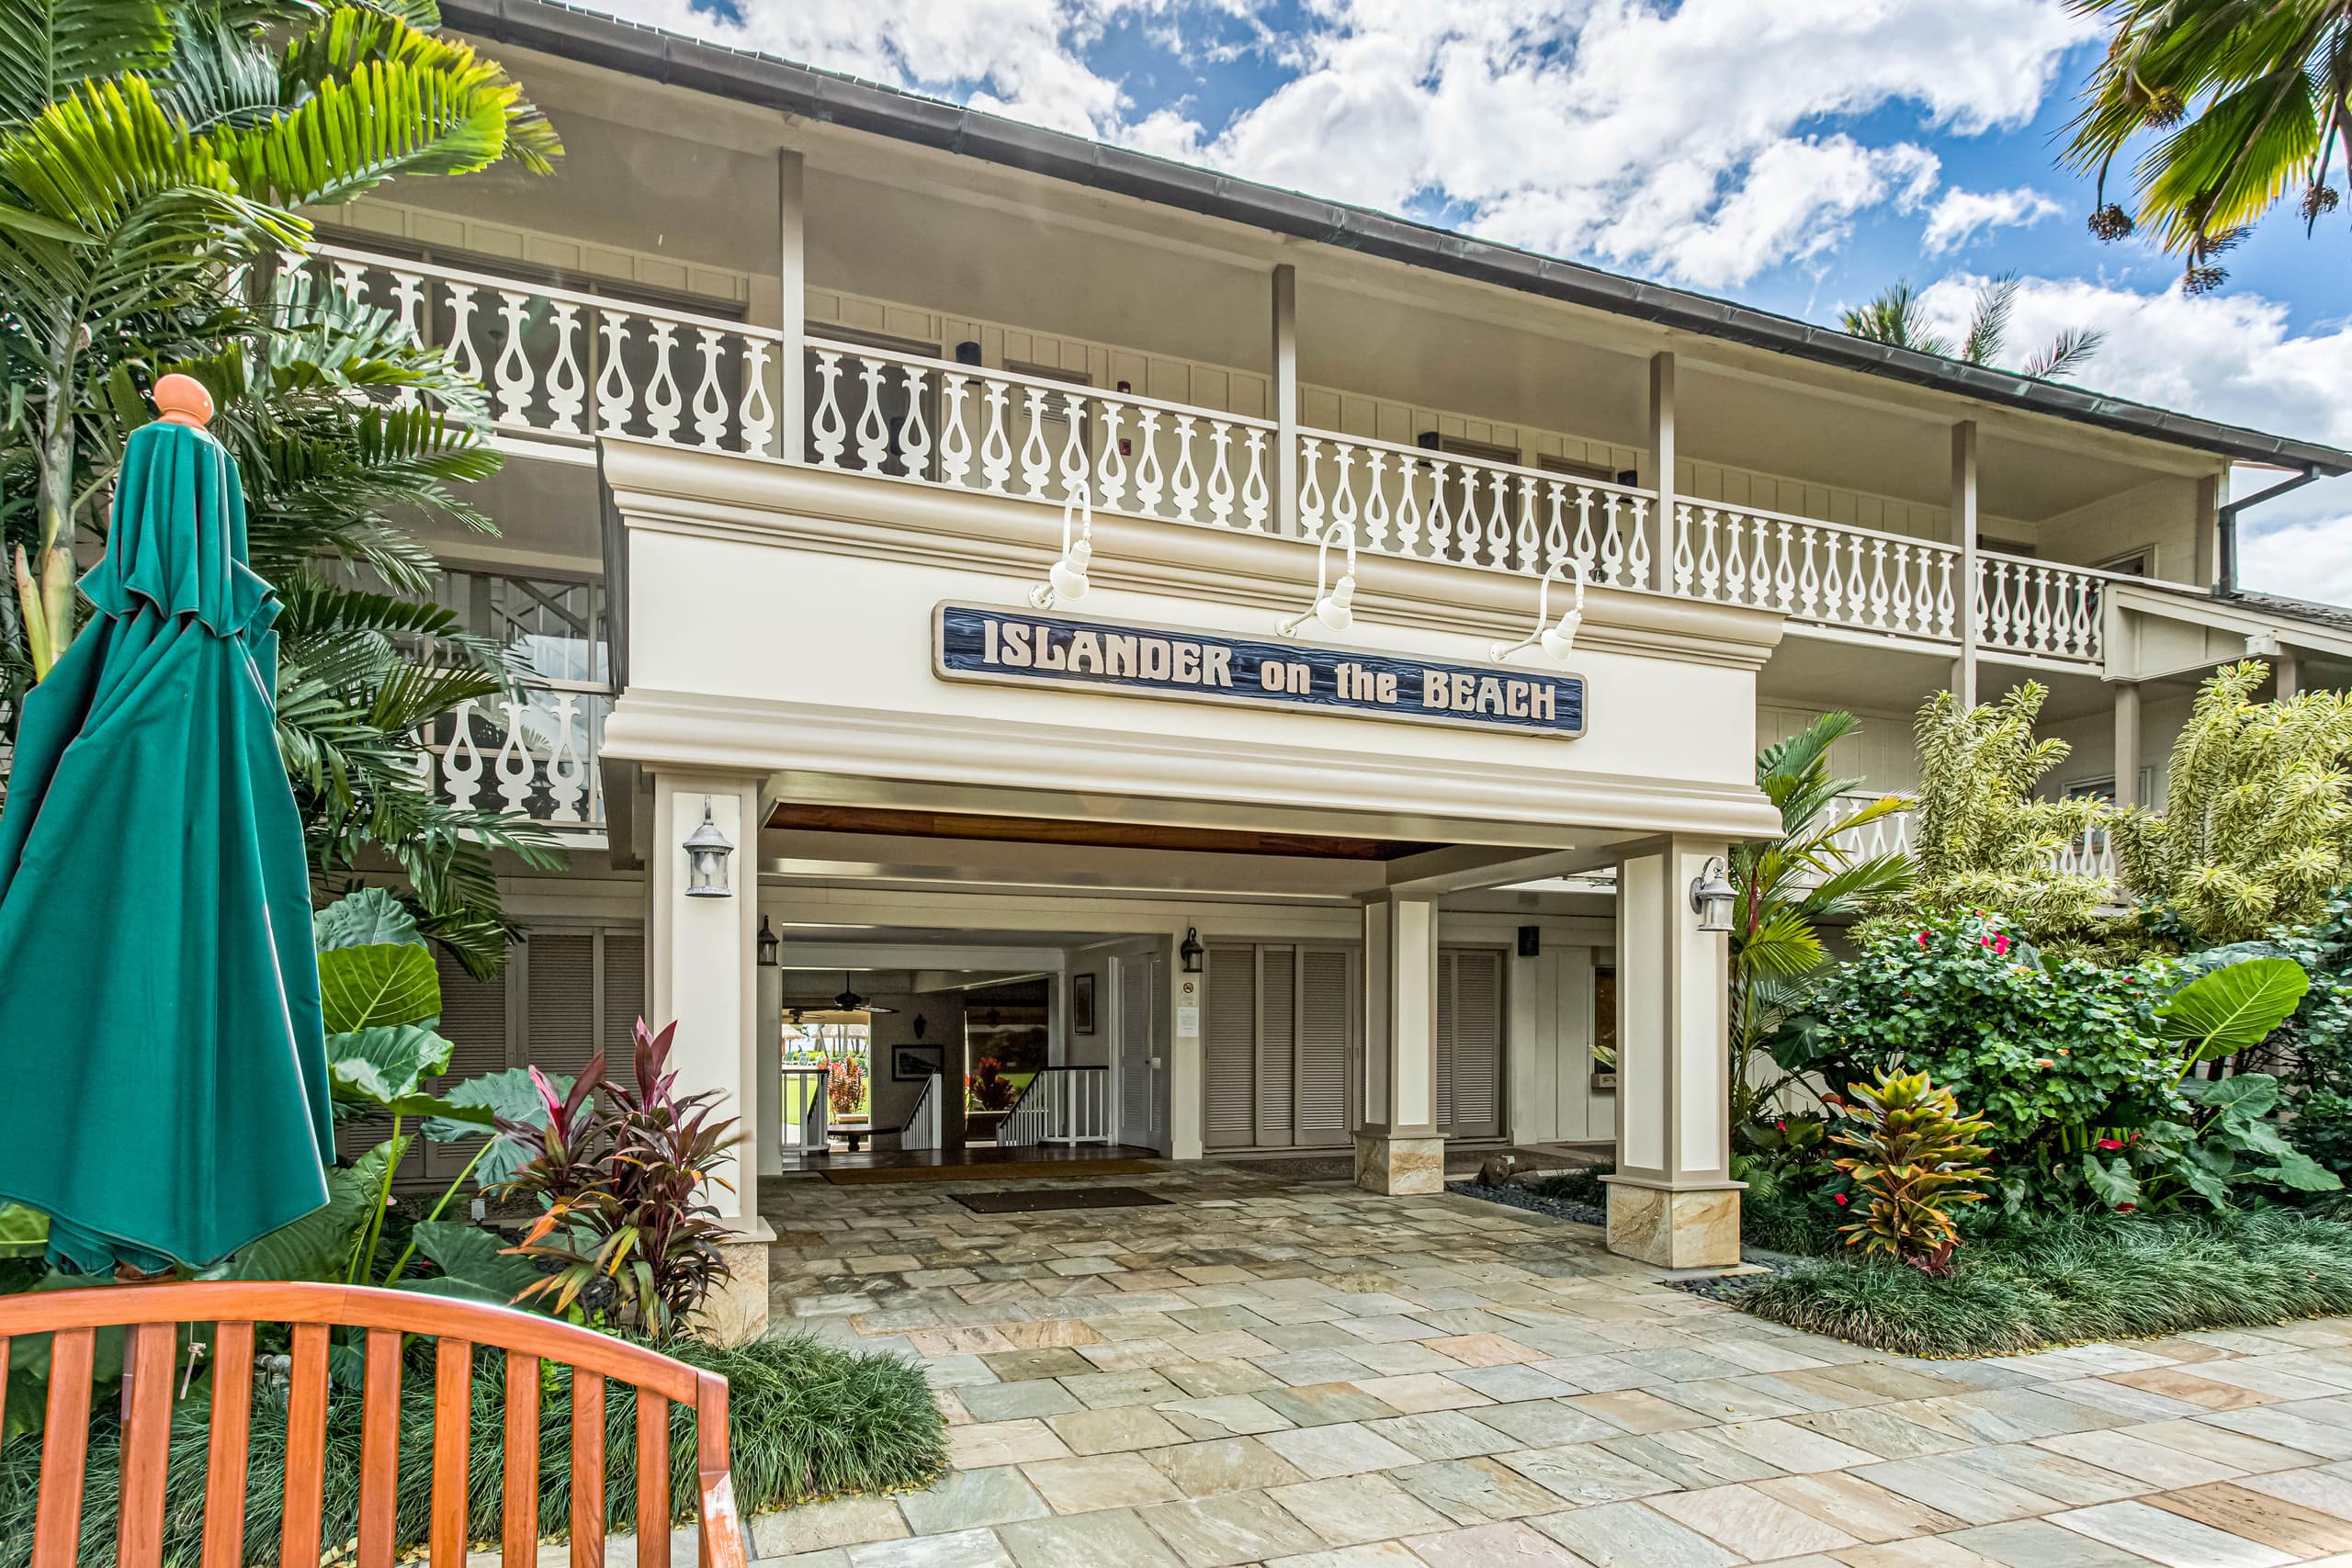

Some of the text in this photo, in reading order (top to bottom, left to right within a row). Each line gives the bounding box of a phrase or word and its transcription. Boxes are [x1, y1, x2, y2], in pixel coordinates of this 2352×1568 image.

[983, 619, 1555, 721] ISLANDER on the BEACH
